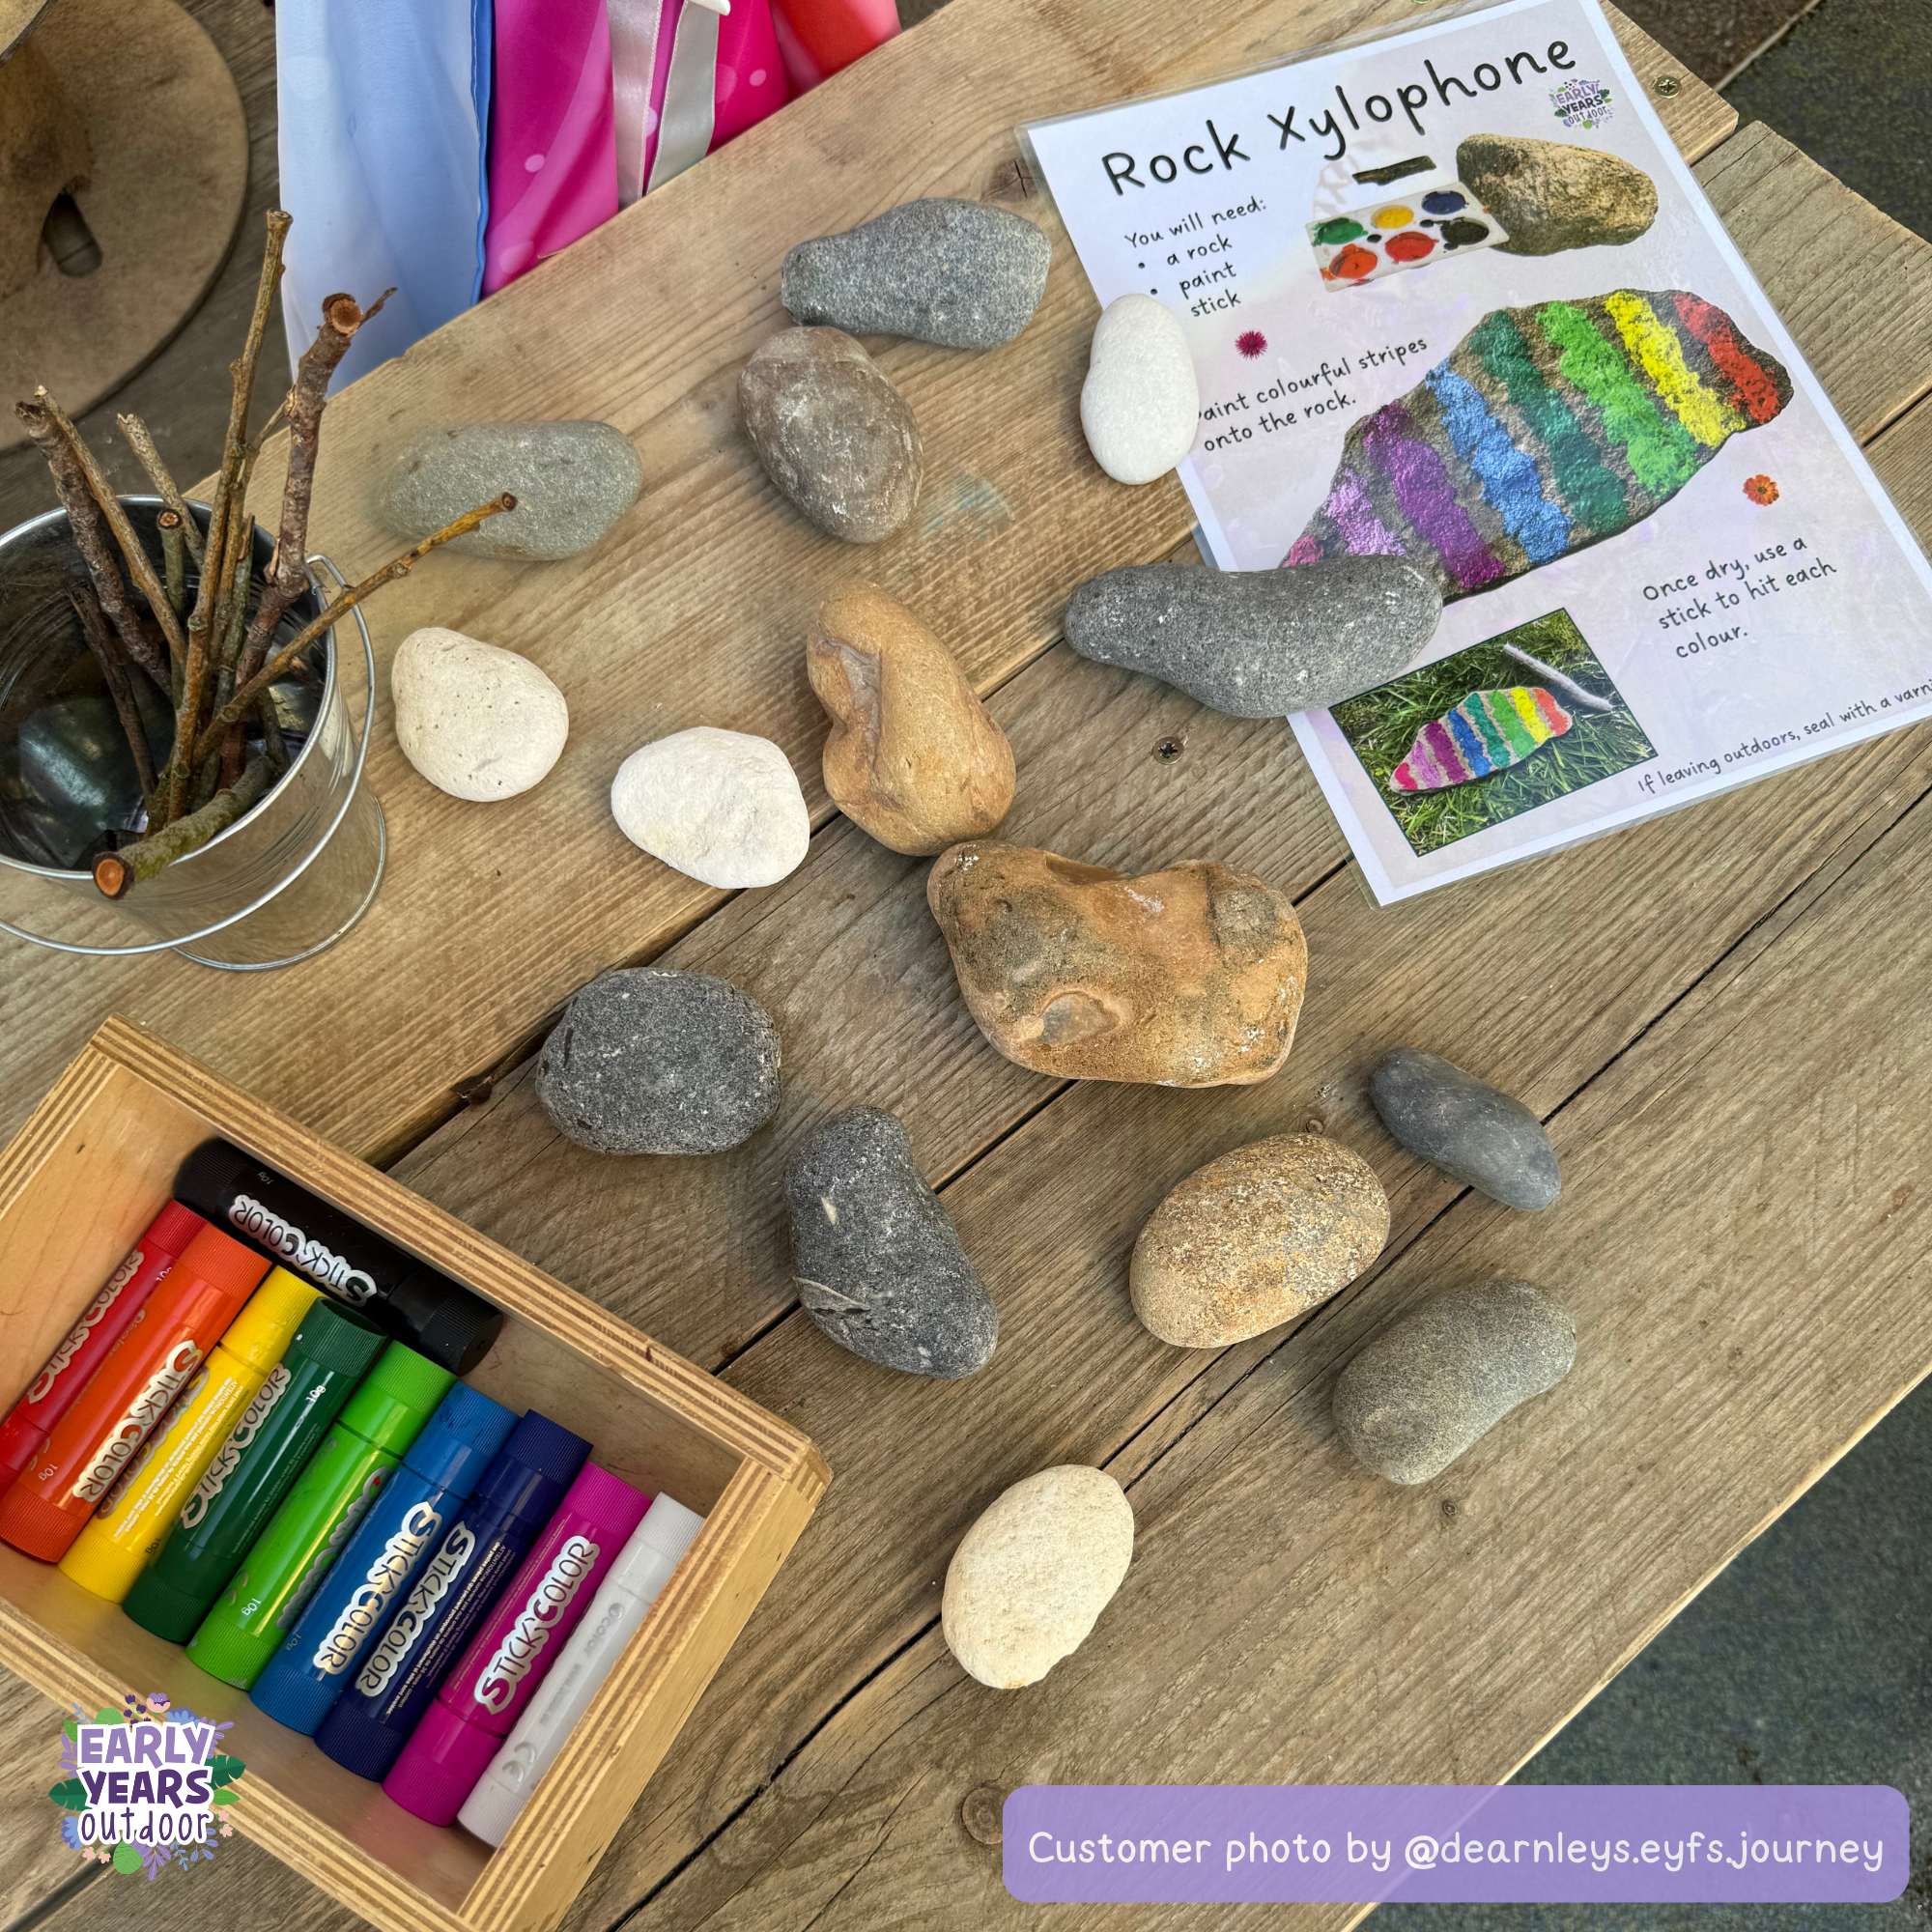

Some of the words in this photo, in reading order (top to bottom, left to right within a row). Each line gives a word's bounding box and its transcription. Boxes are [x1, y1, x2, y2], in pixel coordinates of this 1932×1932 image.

[1555, 83, 1598, 104] EARLY
[1562, 95, 1604, 114] YEARS
[1101, 120, 1250, 196] Rock
[1266, 40, 1577, 160] Xylophone
[1567, 105, 1607, 125] outdoor
[1123, 232, 1164, 248] You
[1169, 212, 1204, 236] will
[1211, 195, 1266, 225] need:
[1166, 253, 1180, 266] a
[1187, 234, 1233, 260] rock
[1179, 261, 1237, 300] paint
[1190, 289, 1241, 318] stick
[1198, 392, 1250, 425] aint
[1256, 357, 1351, 404] colourful
[1358, 338, 1428, 370] stripes
[1204, 425, 1253, 452] onto
[1258, 412, 1297, 434] the
[1303, 389, 1356, 419] rock.
[1642, 574, 1699, 601] Once
[1705, 559, 1750, 581] dry,
[1754, 544, 1788, 563] use
[1793, 537, 1807, 551] a
[1658, 598, 1712, 630] stick
[1715, 591, 1740, 610] to
[1744, 575, 1780, 600] hit
[1786, 557, 1837, 586] each
[1675, 626, 1748, 659] colour.
[1637, 774, 1656, 795] If
[1657, 757, 1722, 786] leaving
[1722, 729, 1802, 763] outdoors,
[1803, 712, 1835, 736] seal
[1838, 699, 1878, 723] with
[1880, 697, 1891, 708] a
[257, 1171, 274, 1185] 10g
[305, 1383, 327, 1406] 10g
[38, 1463, 59, 1482] 10g
[145, 1537, 162, 1555] 10g
[242, 1597, 262, 1616] 10g
[286, 1634, 302, 1651] 10g
